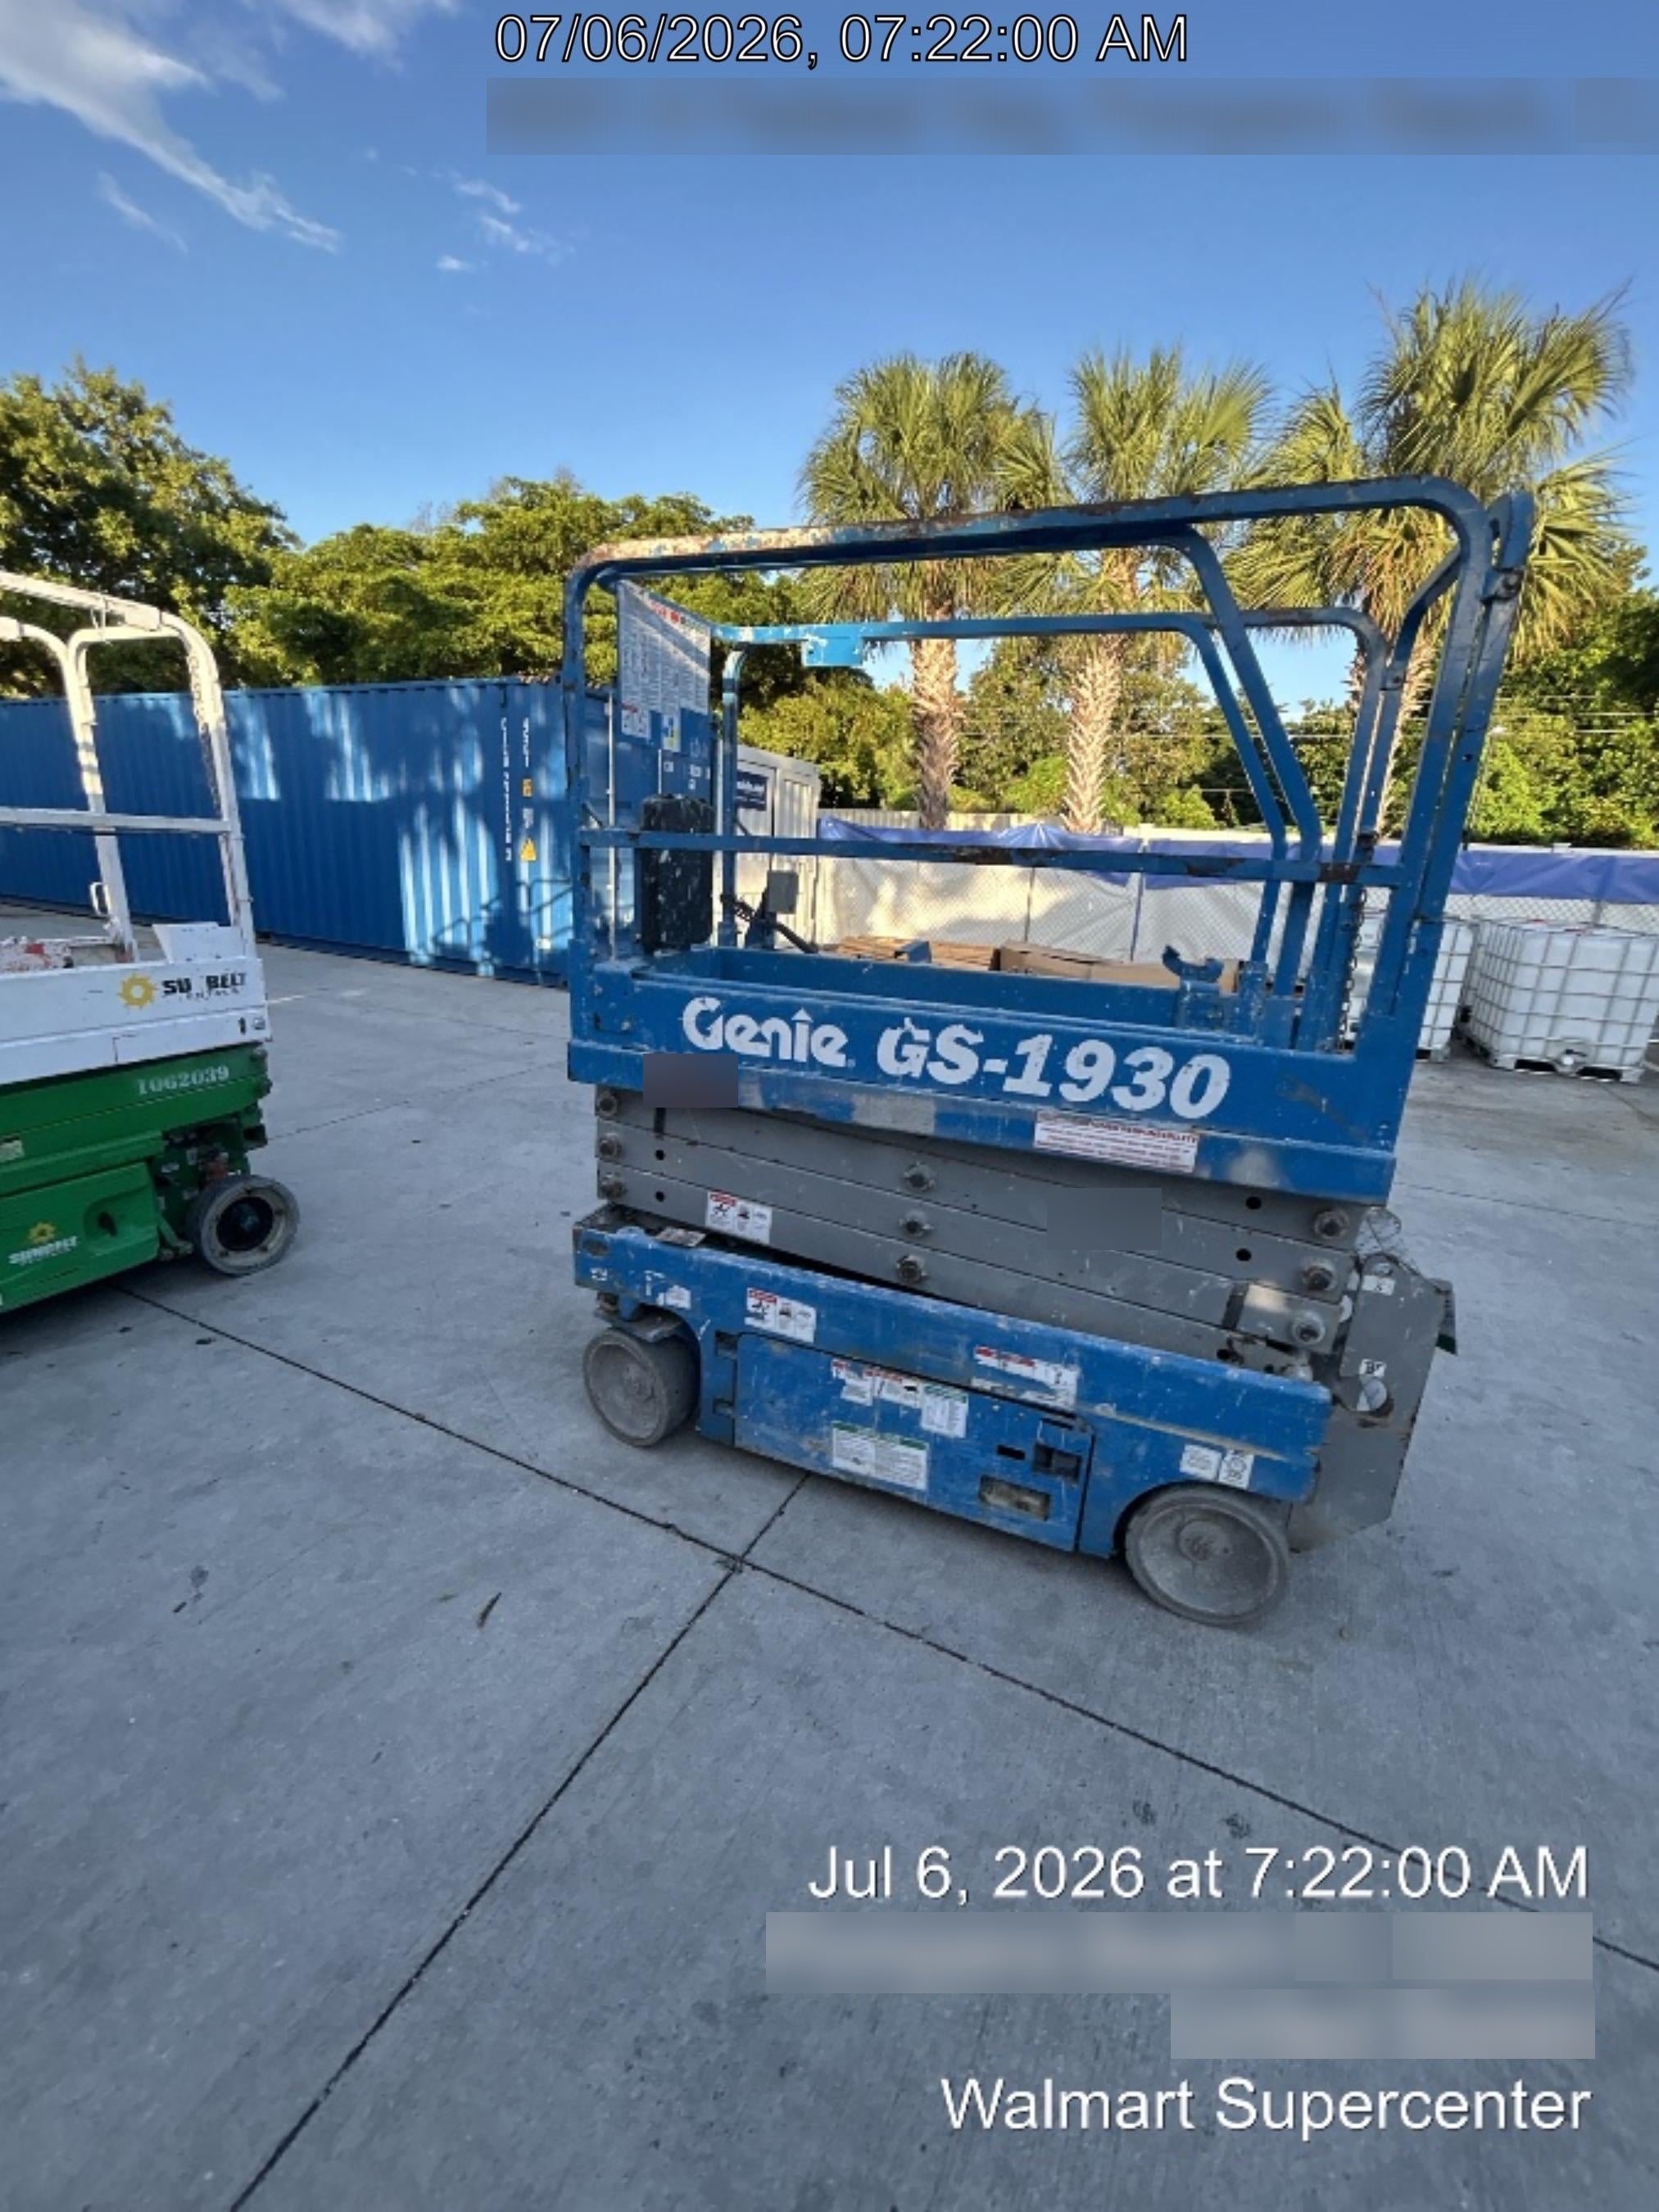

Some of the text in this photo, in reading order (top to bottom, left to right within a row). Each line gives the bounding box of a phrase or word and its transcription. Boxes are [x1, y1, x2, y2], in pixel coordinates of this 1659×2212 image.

[162, 972, 246, 995] SUBELT
[682, 996, 1230, 1119] Genie GS-1930
[138, 1066, 229, 1095] 1062039
